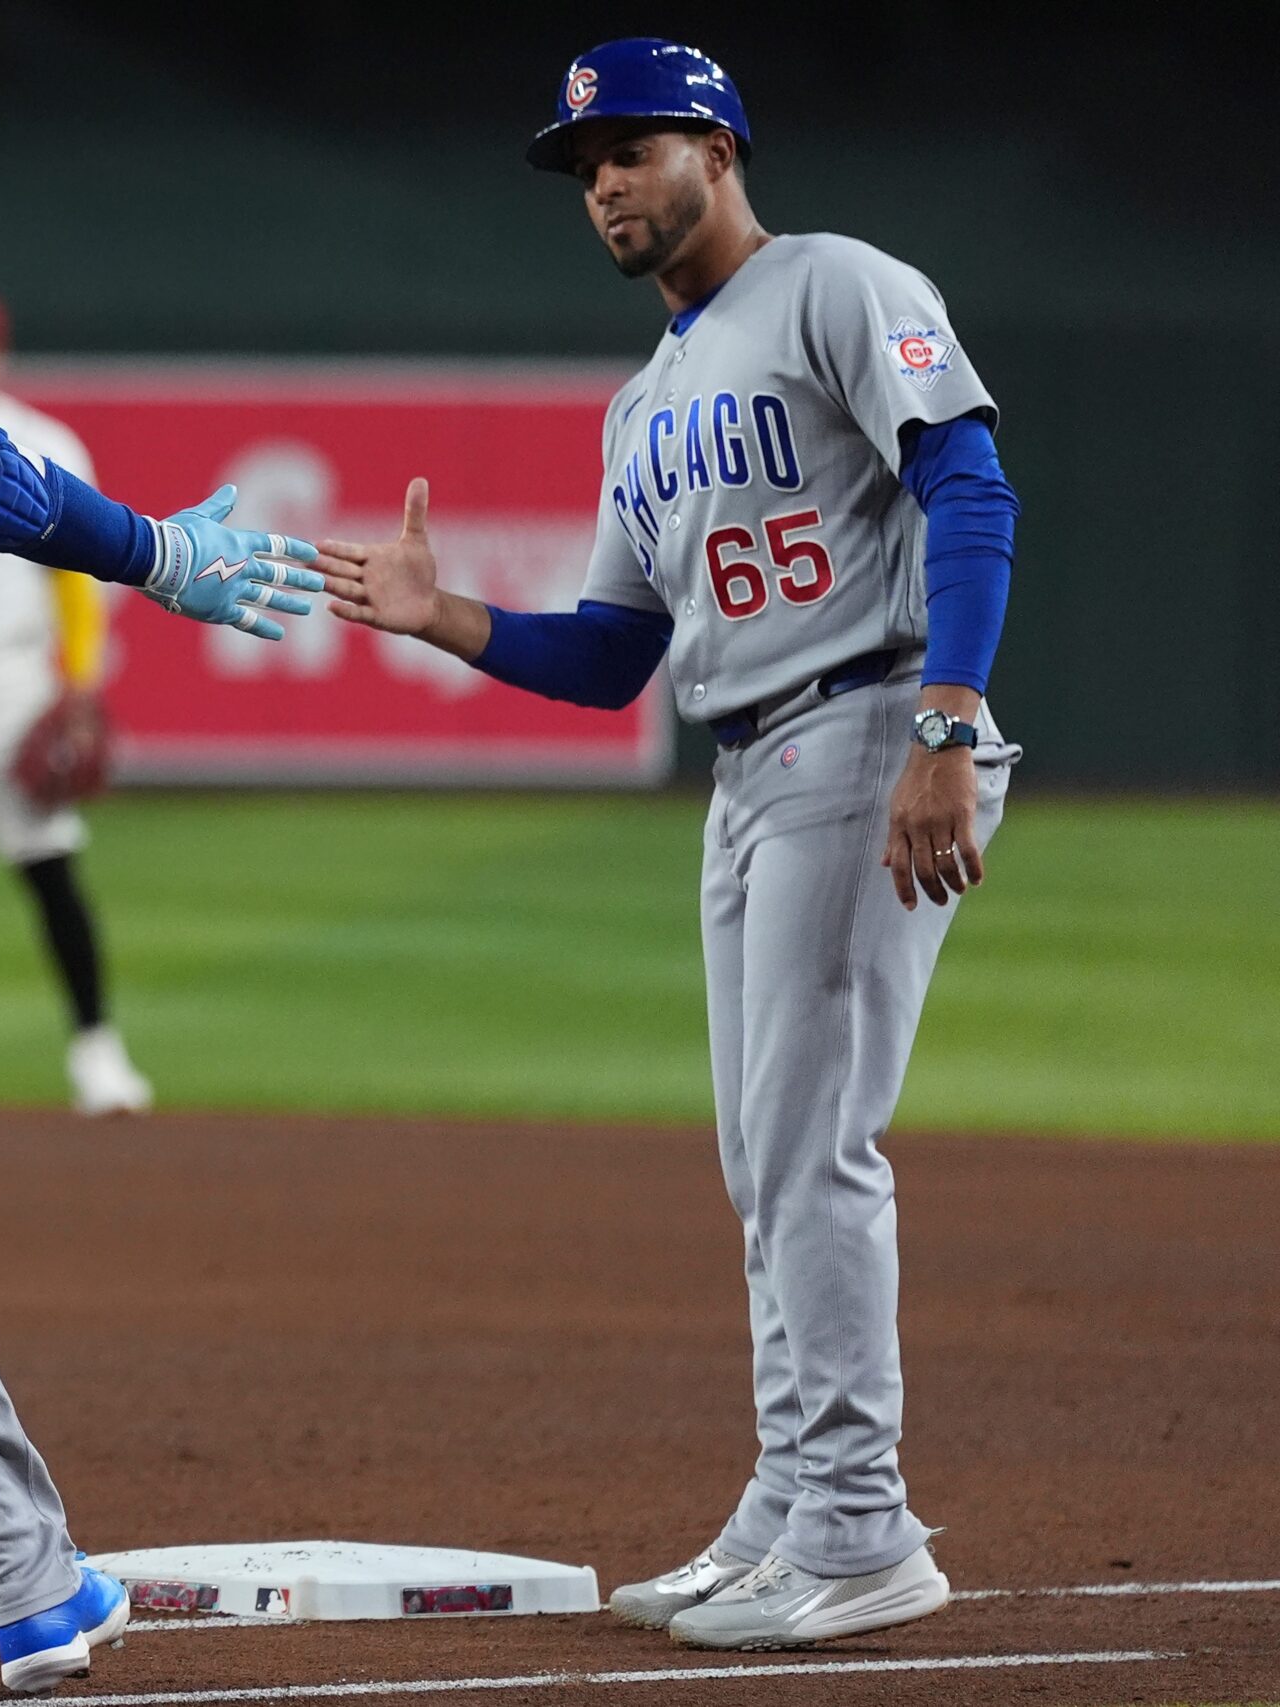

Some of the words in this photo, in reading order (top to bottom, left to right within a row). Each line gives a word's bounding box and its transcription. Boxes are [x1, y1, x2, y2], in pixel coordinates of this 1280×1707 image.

[566, 67, 598, 110] C
[612, 391, 804, 581] CHCAGO
[705, 508, 835, 622] 65
